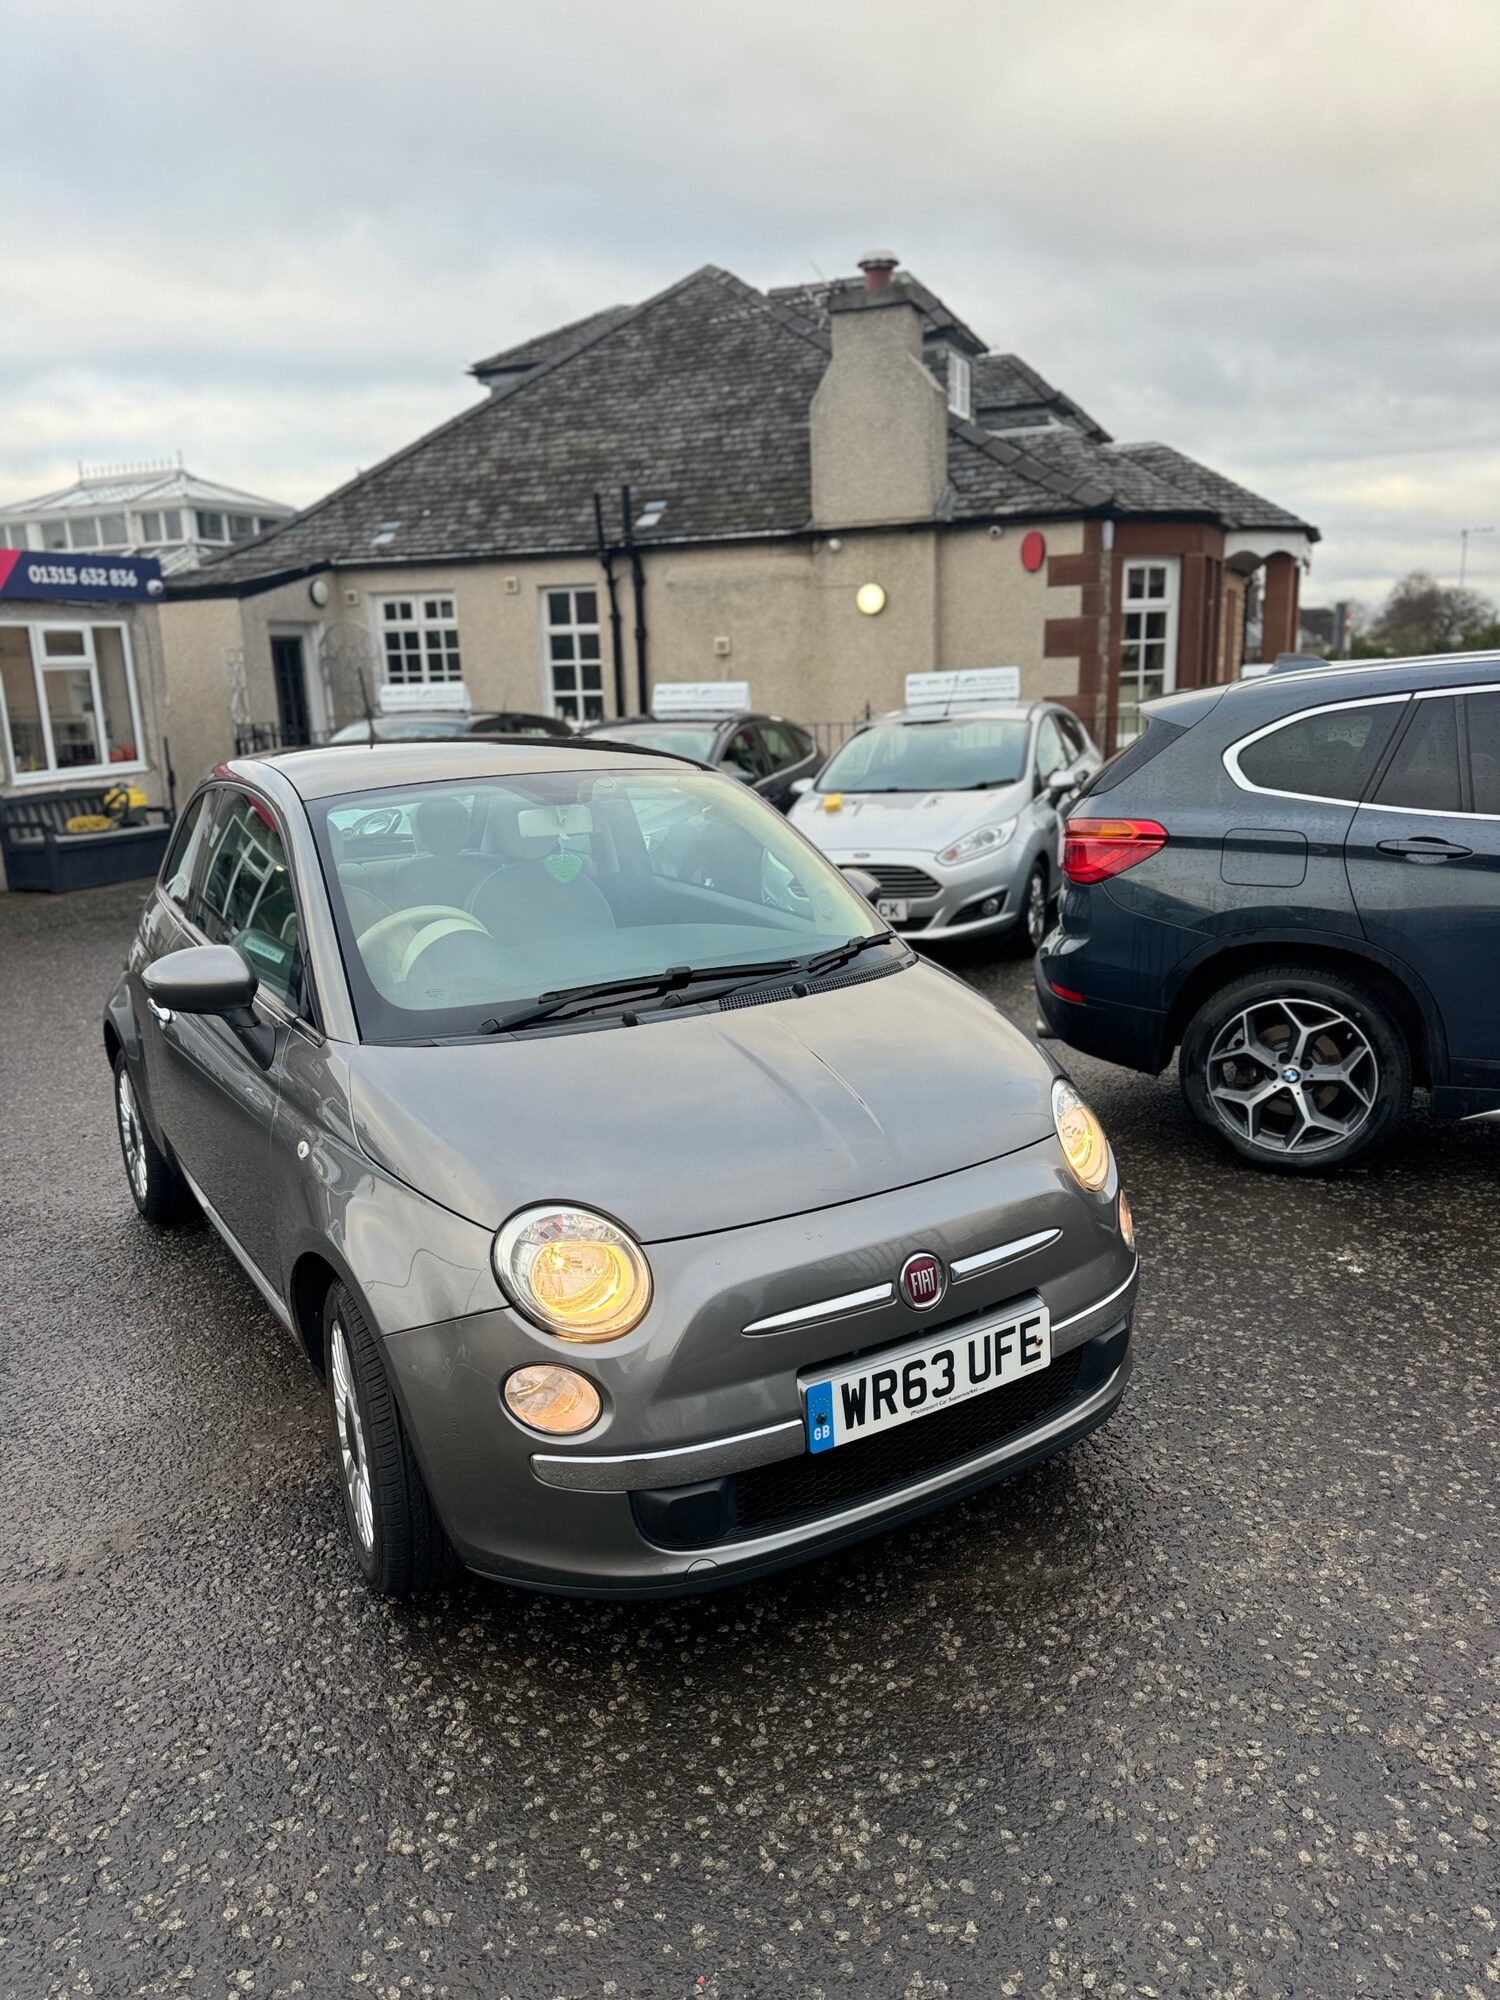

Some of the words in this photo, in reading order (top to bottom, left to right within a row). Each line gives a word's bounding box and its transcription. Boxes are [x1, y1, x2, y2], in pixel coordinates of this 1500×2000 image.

[28, 565, 77, 585] 01315
[79, 567, 109, 586] 632
[879, 903, 900, 917] CK
[910, 1267, 936, 1296] FIAT
[841, 1350, 955, 1430] WR63
[968, 1316, 1041, 1384] UFE
[814, 1425, 830, 1440] GB
